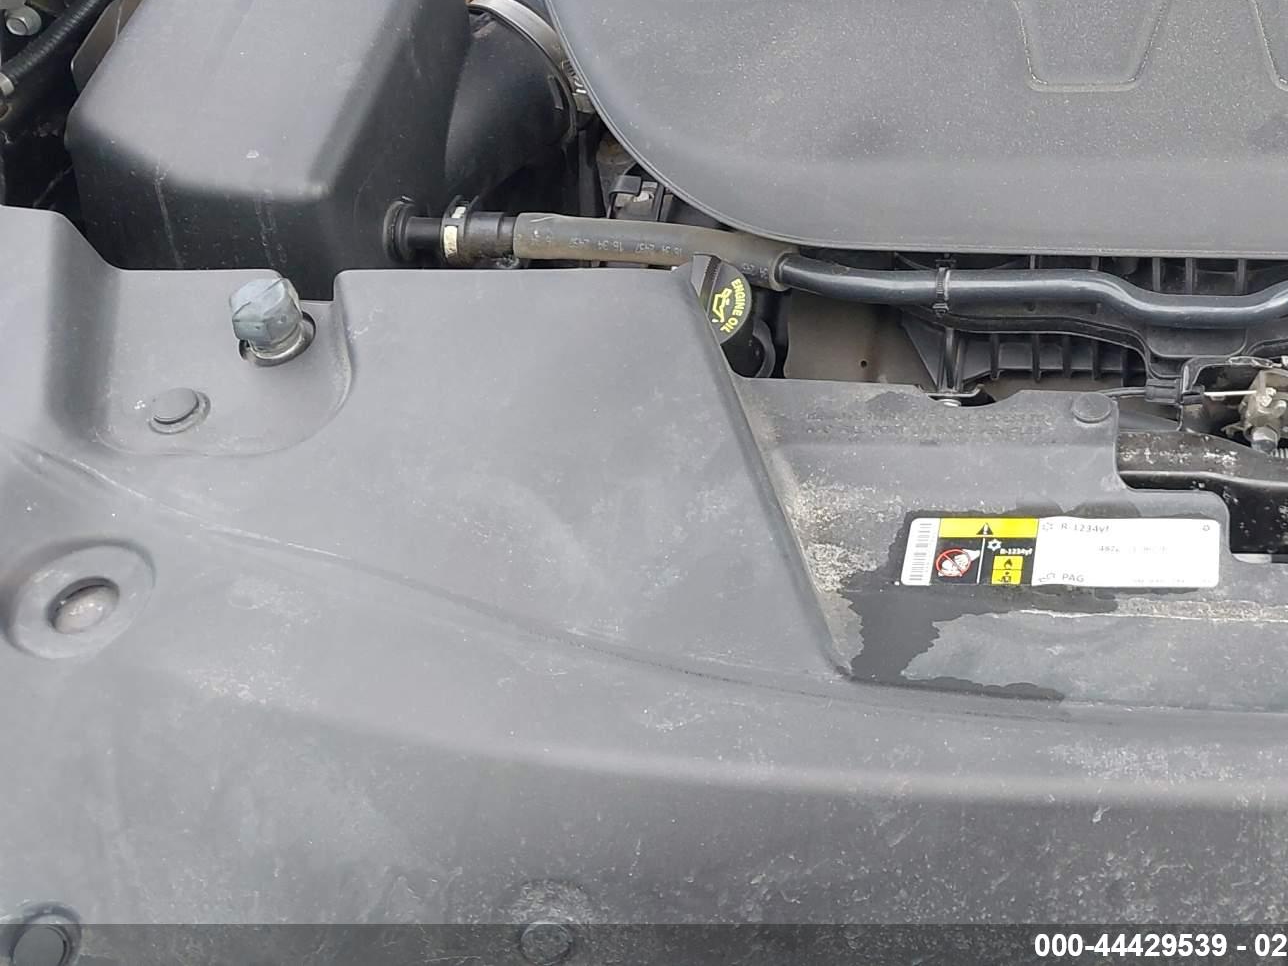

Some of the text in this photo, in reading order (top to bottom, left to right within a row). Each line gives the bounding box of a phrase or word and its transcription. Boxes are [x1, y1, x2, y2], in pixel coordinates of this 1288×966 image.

[720, 279, 746, 333] ENGINE OIL
[1062, 573, 1085, 583] PAG
